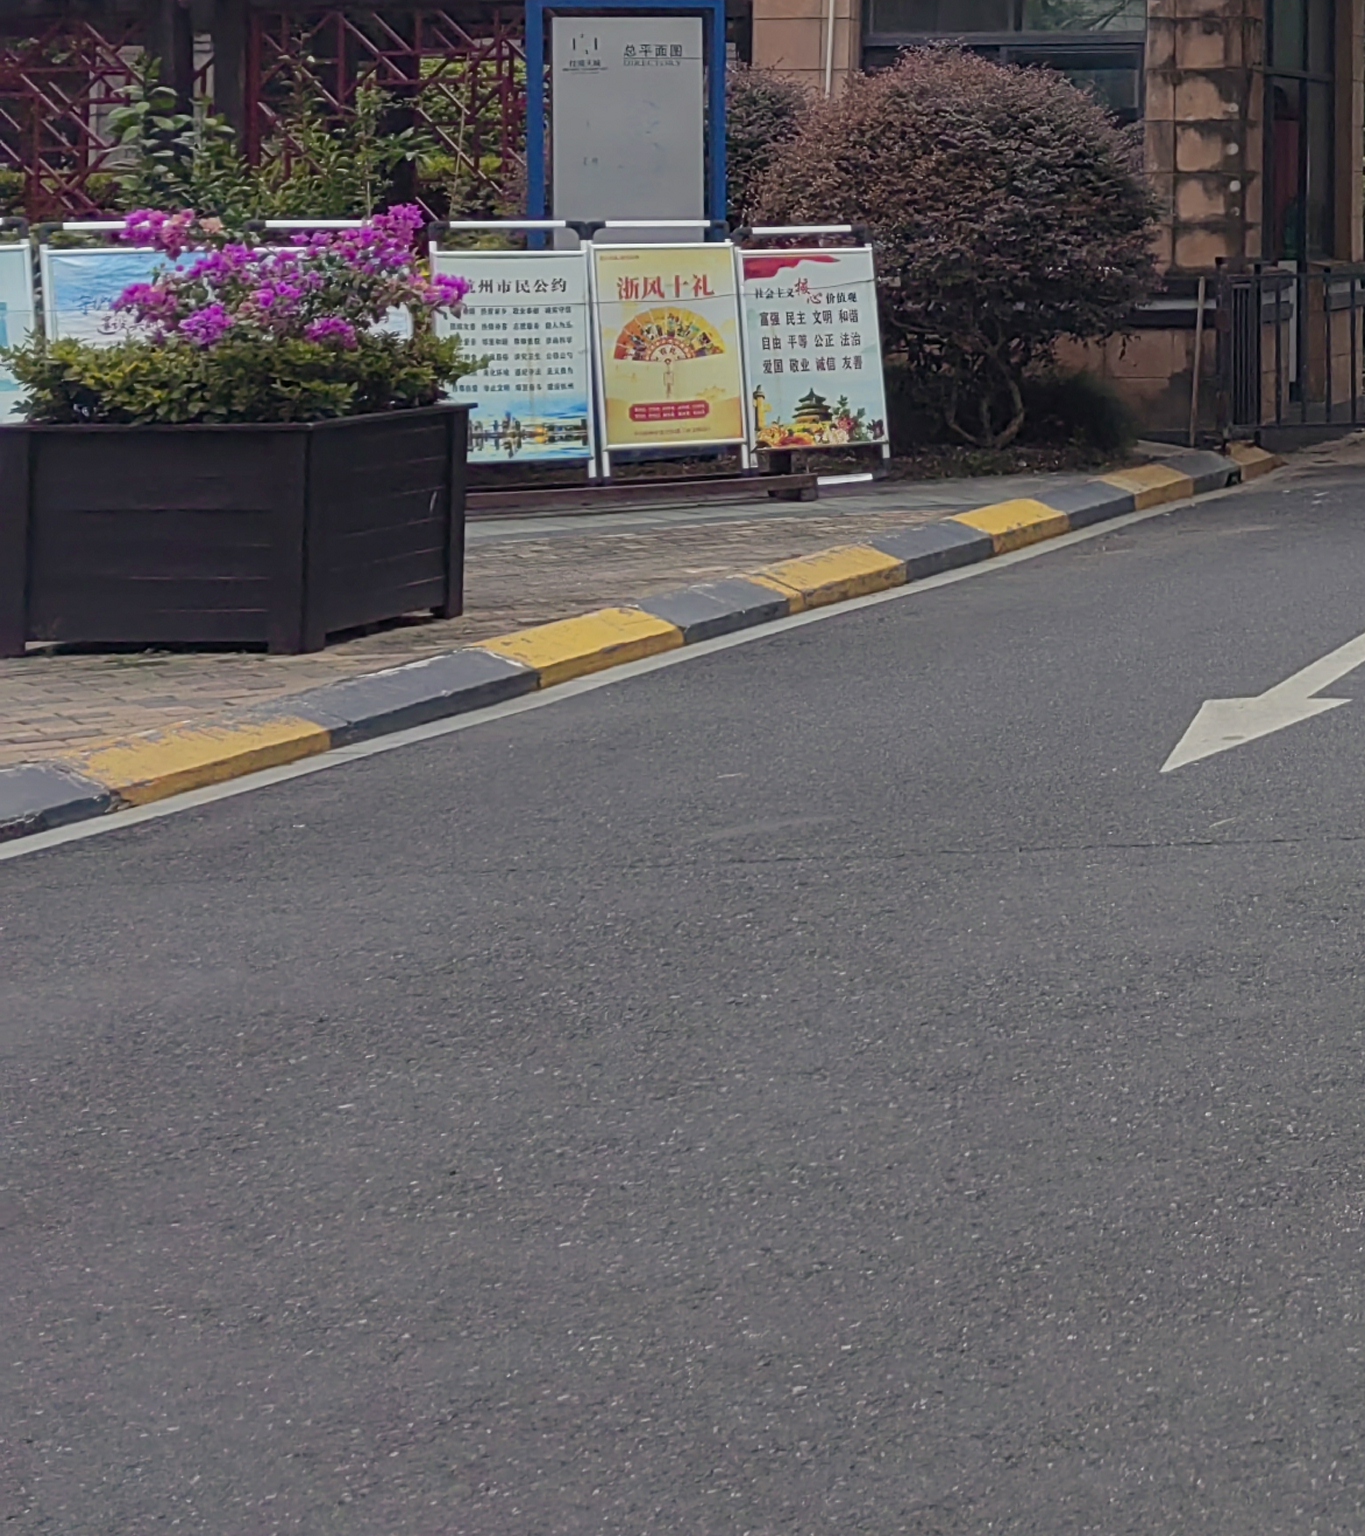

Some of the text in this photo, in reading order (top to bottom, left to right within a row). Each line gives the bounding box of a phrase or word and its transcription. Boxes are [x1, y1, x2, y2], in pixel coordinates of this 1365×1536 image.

[624, 44, 682, 57] 总平面图
[616, 274, 715, 300] 浙风十礼
[760, 309, 859, 326] 富强 民主 文明 和谐
[762, 332, 861, 350] 自由 平等 公正 法治
[763, 355, 863, 374] 爱国 敬业 诚信 友善
